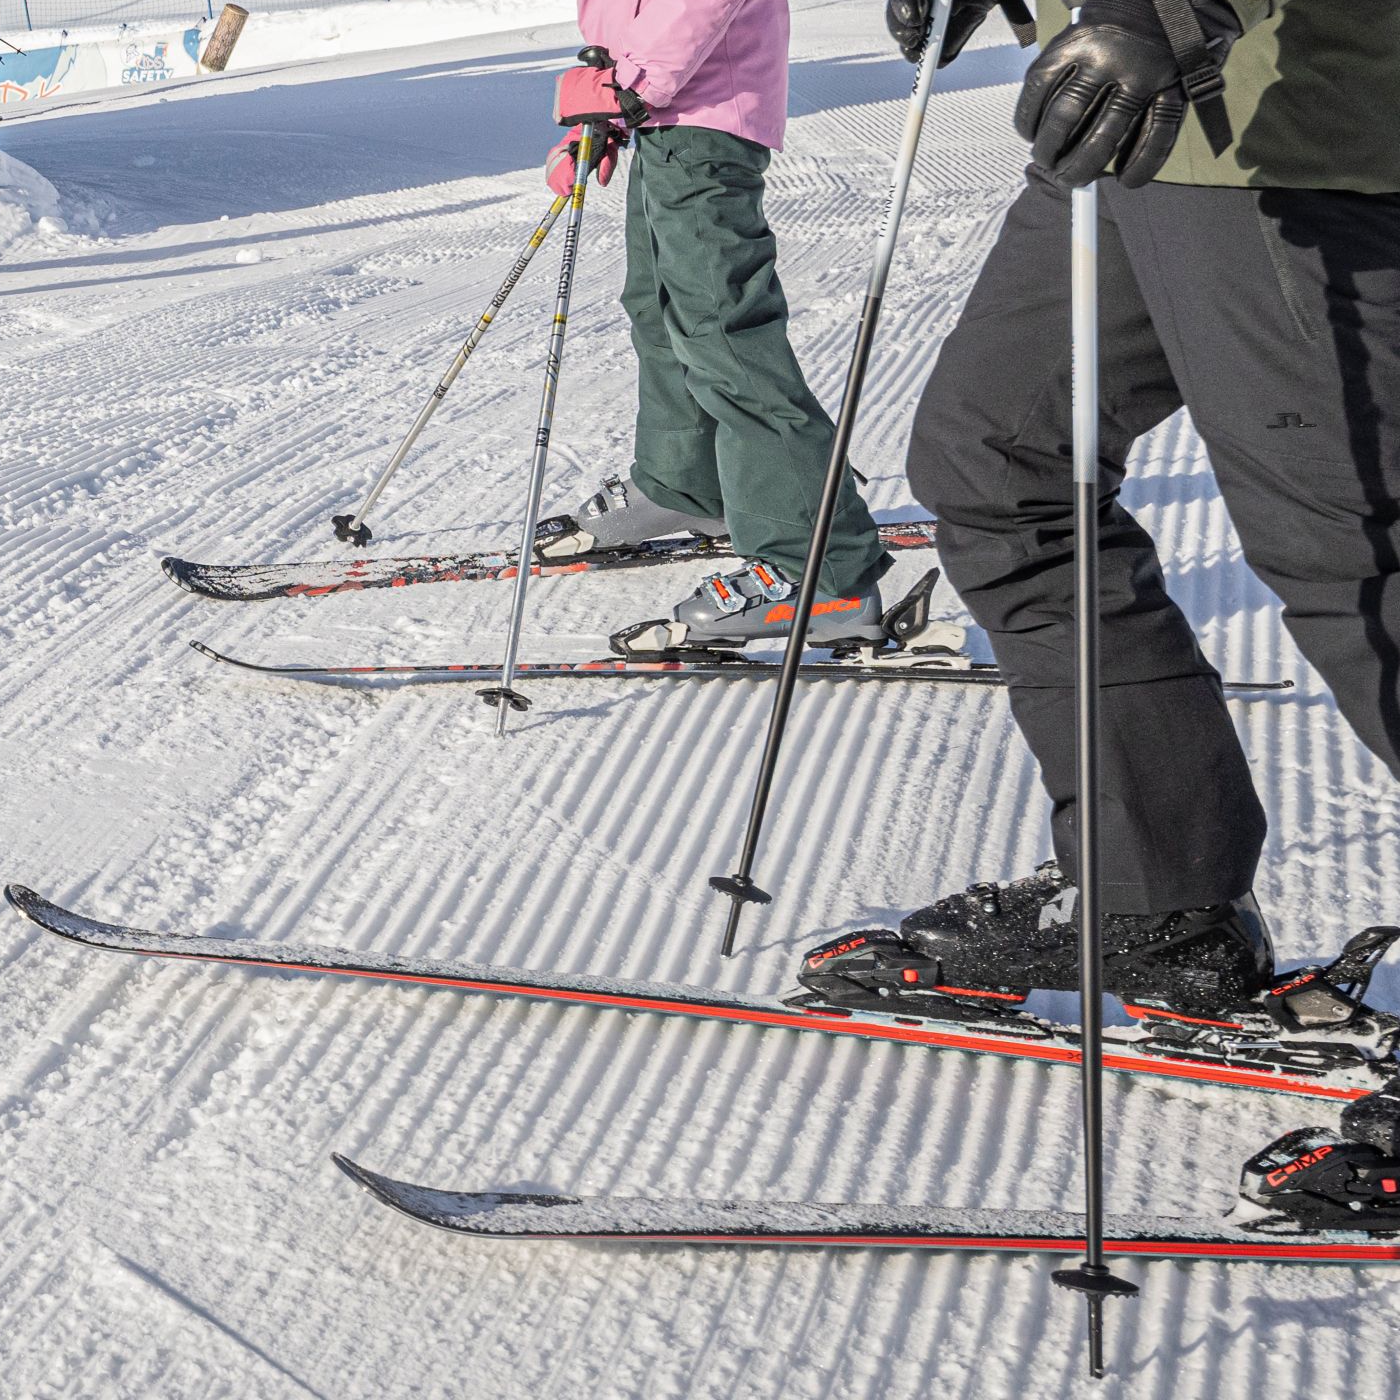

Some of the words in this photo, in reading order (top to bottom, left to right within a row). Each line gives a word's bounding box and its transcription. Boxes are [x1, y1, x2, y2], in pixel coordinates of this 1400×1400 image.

[122, 69, 174, 84] SAFETY
[491, 255, 532, 309] ROSSIGNOL
[556, 221, 578, 299] ROSSIGNOL
[1266, 1145, 1334, 1188] COMP
